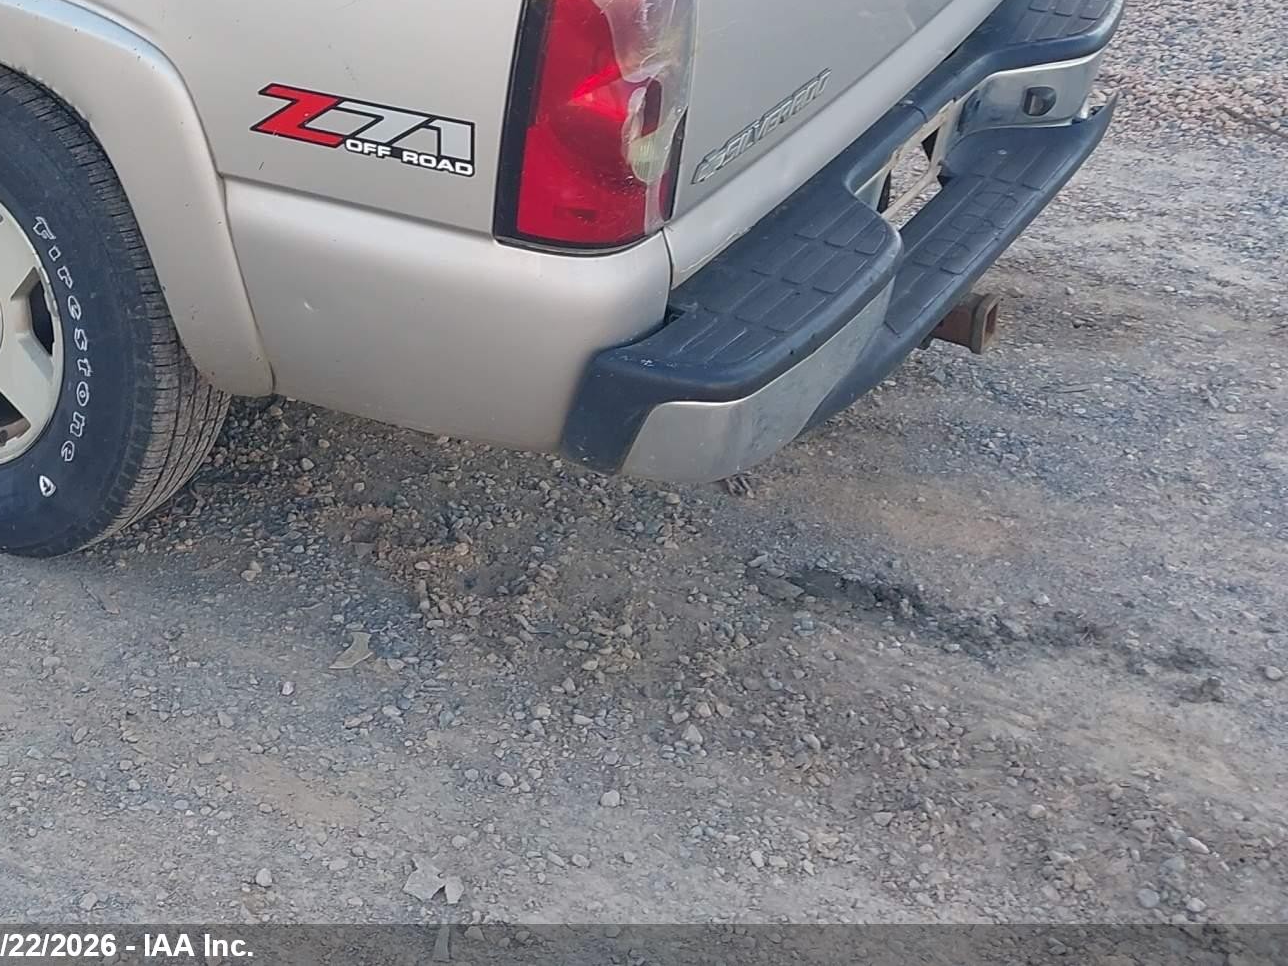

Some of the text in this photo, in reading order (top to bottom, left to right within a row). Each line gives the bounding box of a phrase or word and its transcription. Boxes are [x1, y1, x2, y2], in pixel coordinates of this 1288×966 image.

[250, 82, 476, 164] Z71
[345, 139, 474, 176] OFF ROAD
[32, 216, 94, 462] Firestone
